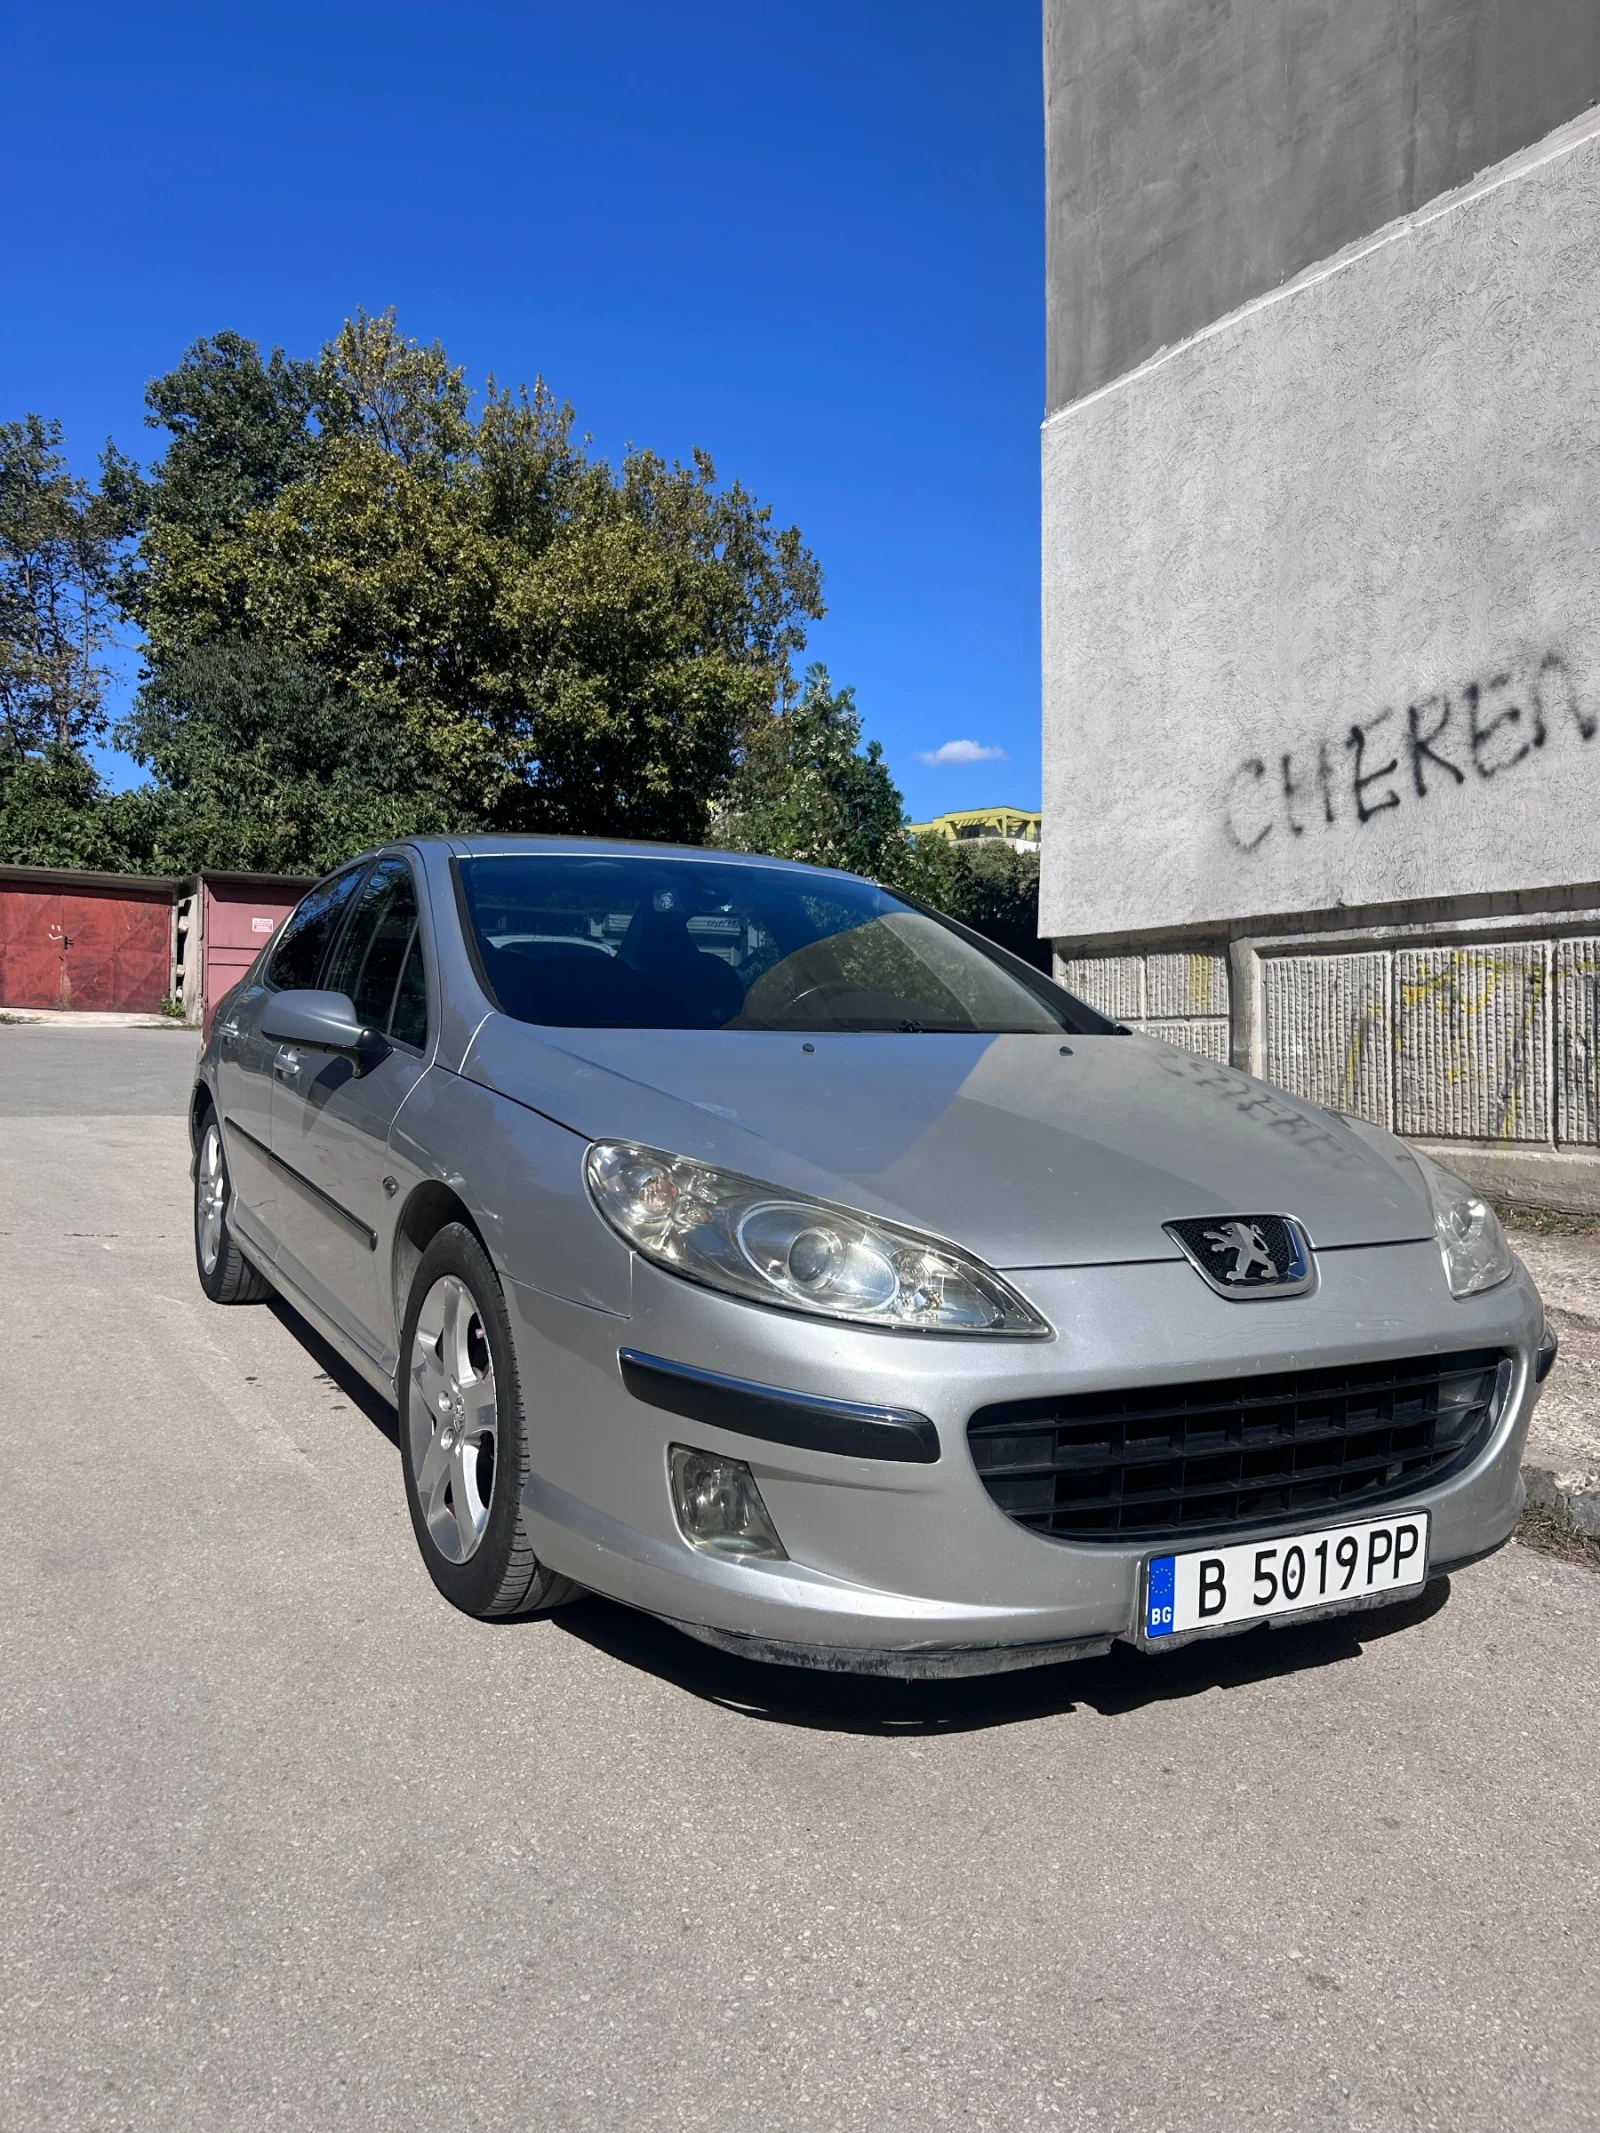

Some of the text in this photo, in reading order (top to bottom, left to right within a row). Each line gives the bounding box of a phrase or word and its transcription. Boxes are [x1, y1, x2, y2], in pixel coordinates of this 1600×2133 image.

[1199, 1524, 1419, 1618] B 5019PP
[1151, 1606, 1172, 1625] BG
